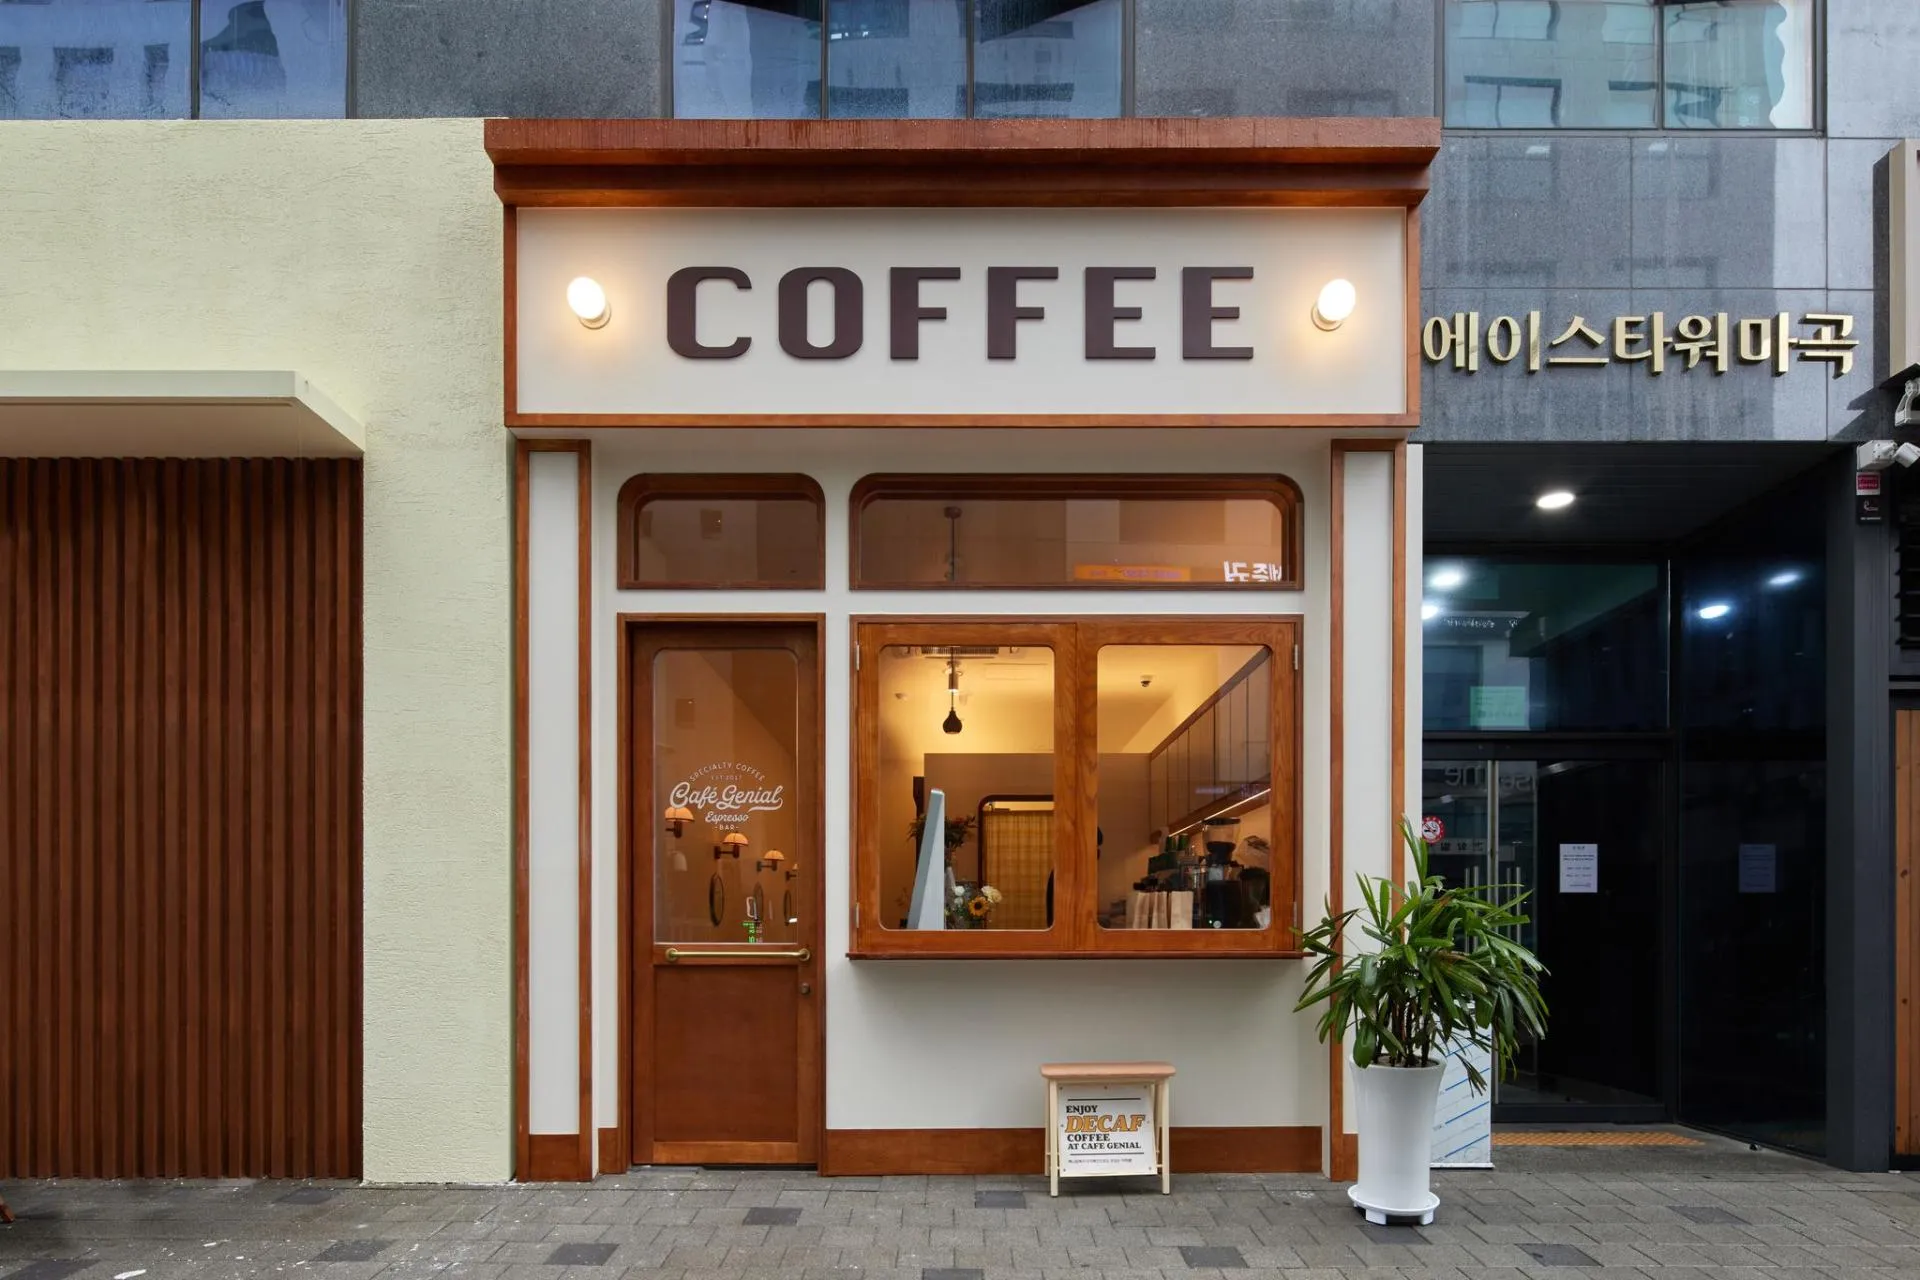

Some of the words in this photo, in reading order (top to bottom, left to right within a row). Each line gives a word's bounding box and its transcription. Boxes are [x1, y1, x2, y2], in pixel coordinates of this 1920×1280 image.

[667, 266, 1254, 359] COFFEE
[1422, 310, 1860, 379] 에이스타워마곡
[690, 761, 732, 782] SPECIALTY
[735, 763, 766, 782] COFFEE
[669, 781, 719, 809] Café
[716, 784, 784, 813] Genial
[705, 811, 749, 825] Espresso
[1066, 1105, 1098, 1115] ENJOY
[1064, 1114, 1146, 1133] DECAF
[1067, 1133, 1111, 1142] COFFEE
[1081, 1142, 1105, 1150] CAFE
[1106, 1141, 1142, 1149] GENIAL
